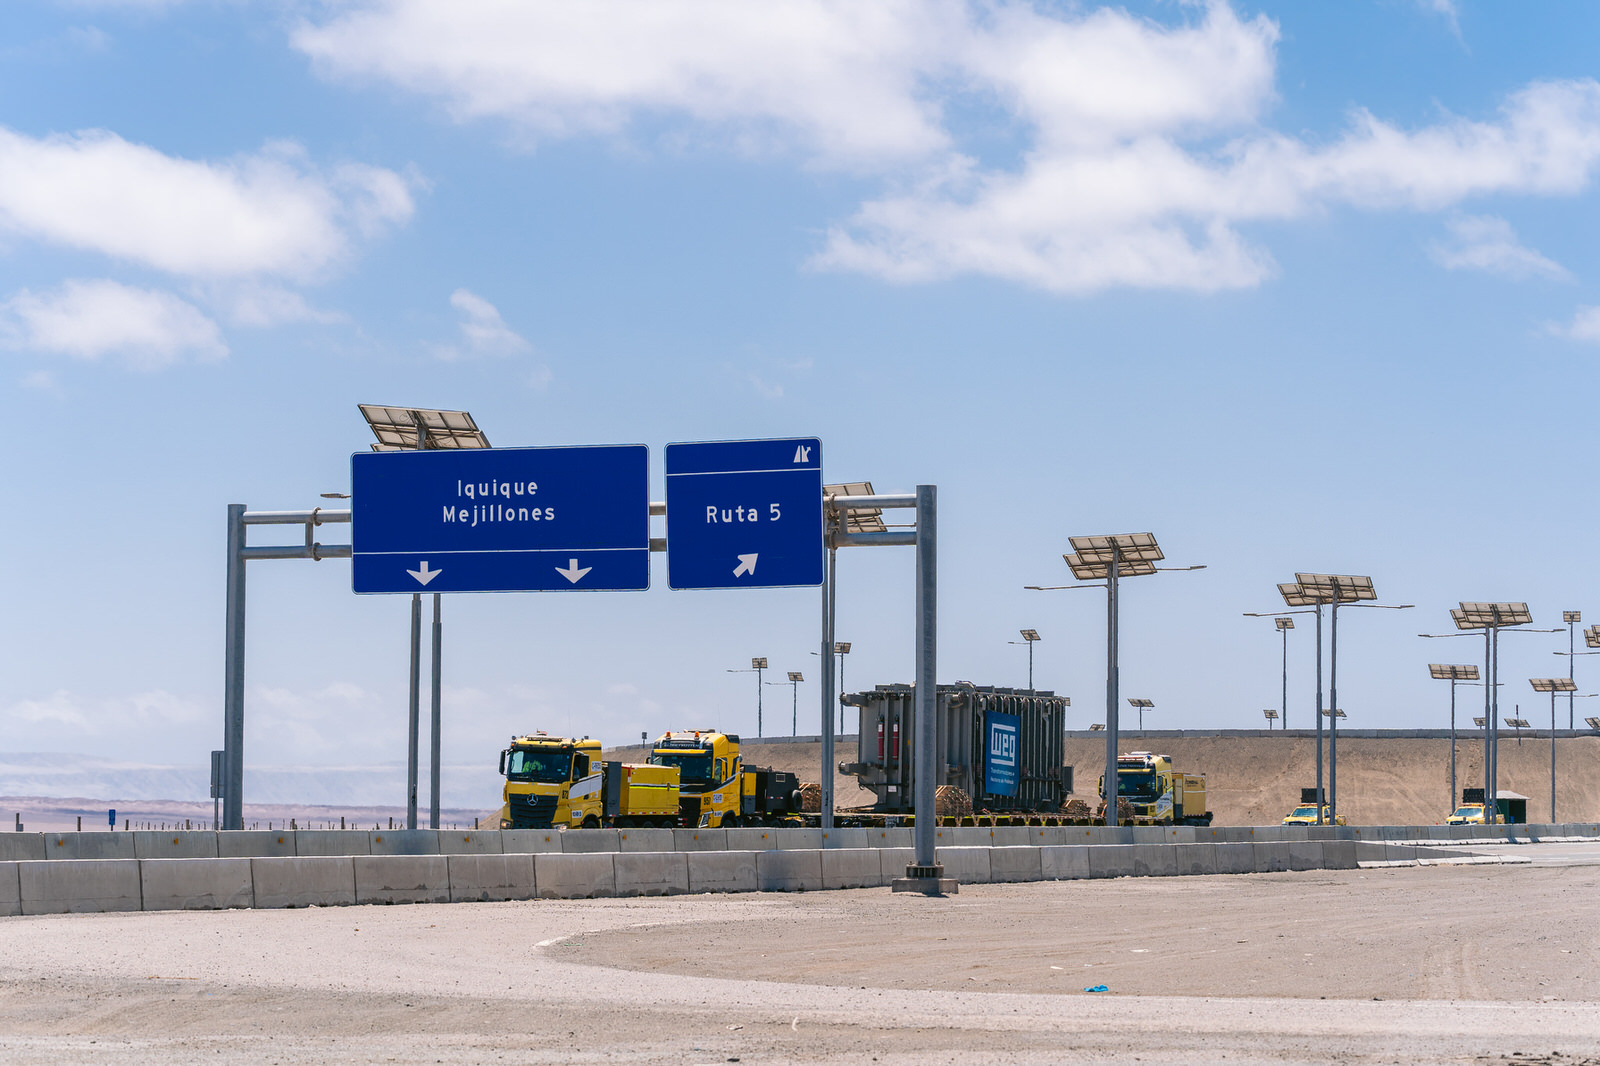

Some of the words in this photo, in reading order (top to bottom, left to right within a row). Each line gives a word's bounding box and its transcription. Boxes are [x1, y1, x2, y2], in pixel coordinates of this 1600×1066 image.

[457, 479, 539, 499] Iquique
[443, 504, 555, 527] Mejillones
[706, 506, 759, 524] Ruta
[770, 503, 782, 522] 5
